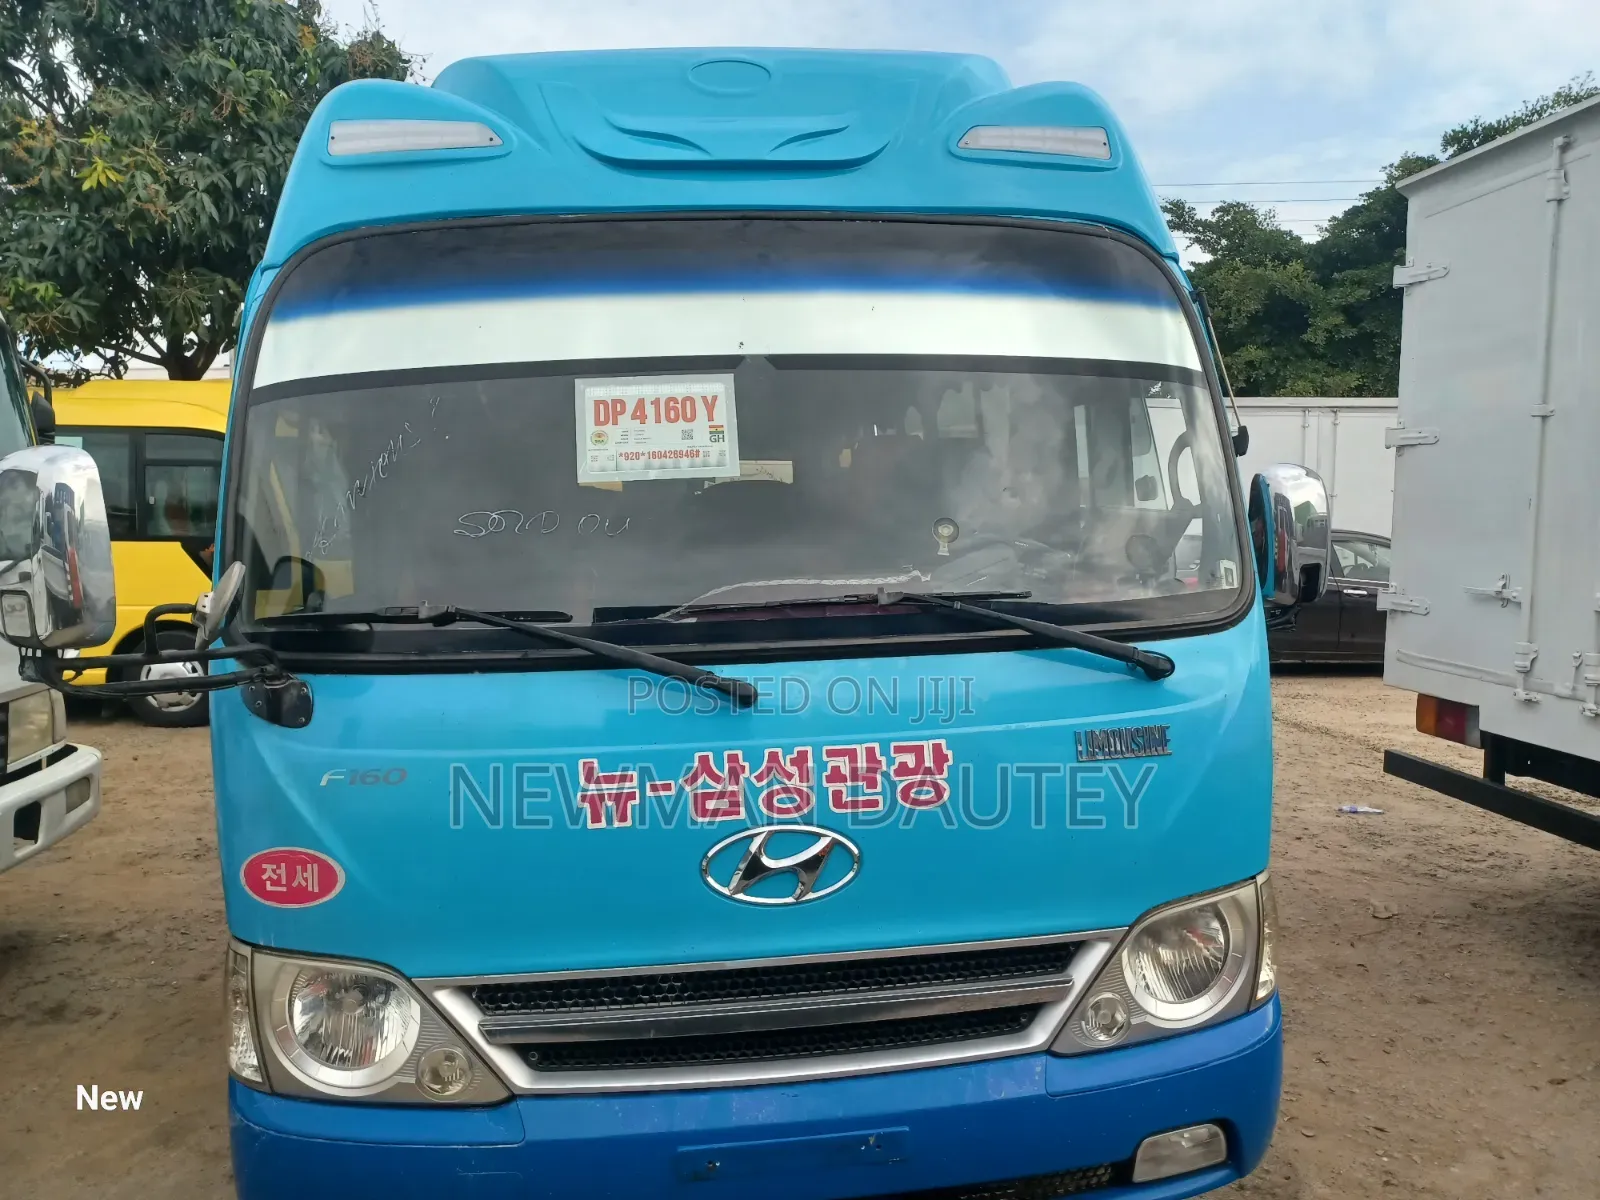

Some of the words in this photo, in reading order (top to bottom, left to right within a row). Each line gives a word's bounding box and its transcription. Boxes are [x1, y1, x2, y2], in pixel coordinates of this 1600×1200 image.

[593, 399, 627, 427] DP
[630, 396, 697, 425] 4160
[701, 395, 718, 422] Y
[709, 434, 725, 443] GH
[1075, 724, 1173, 763] LIMOUSINE
[319, 767, 408, 787] F160
[577, 738, 953, 829] 뉴-삼성관광
[260, 862, 319, 893] 전세
